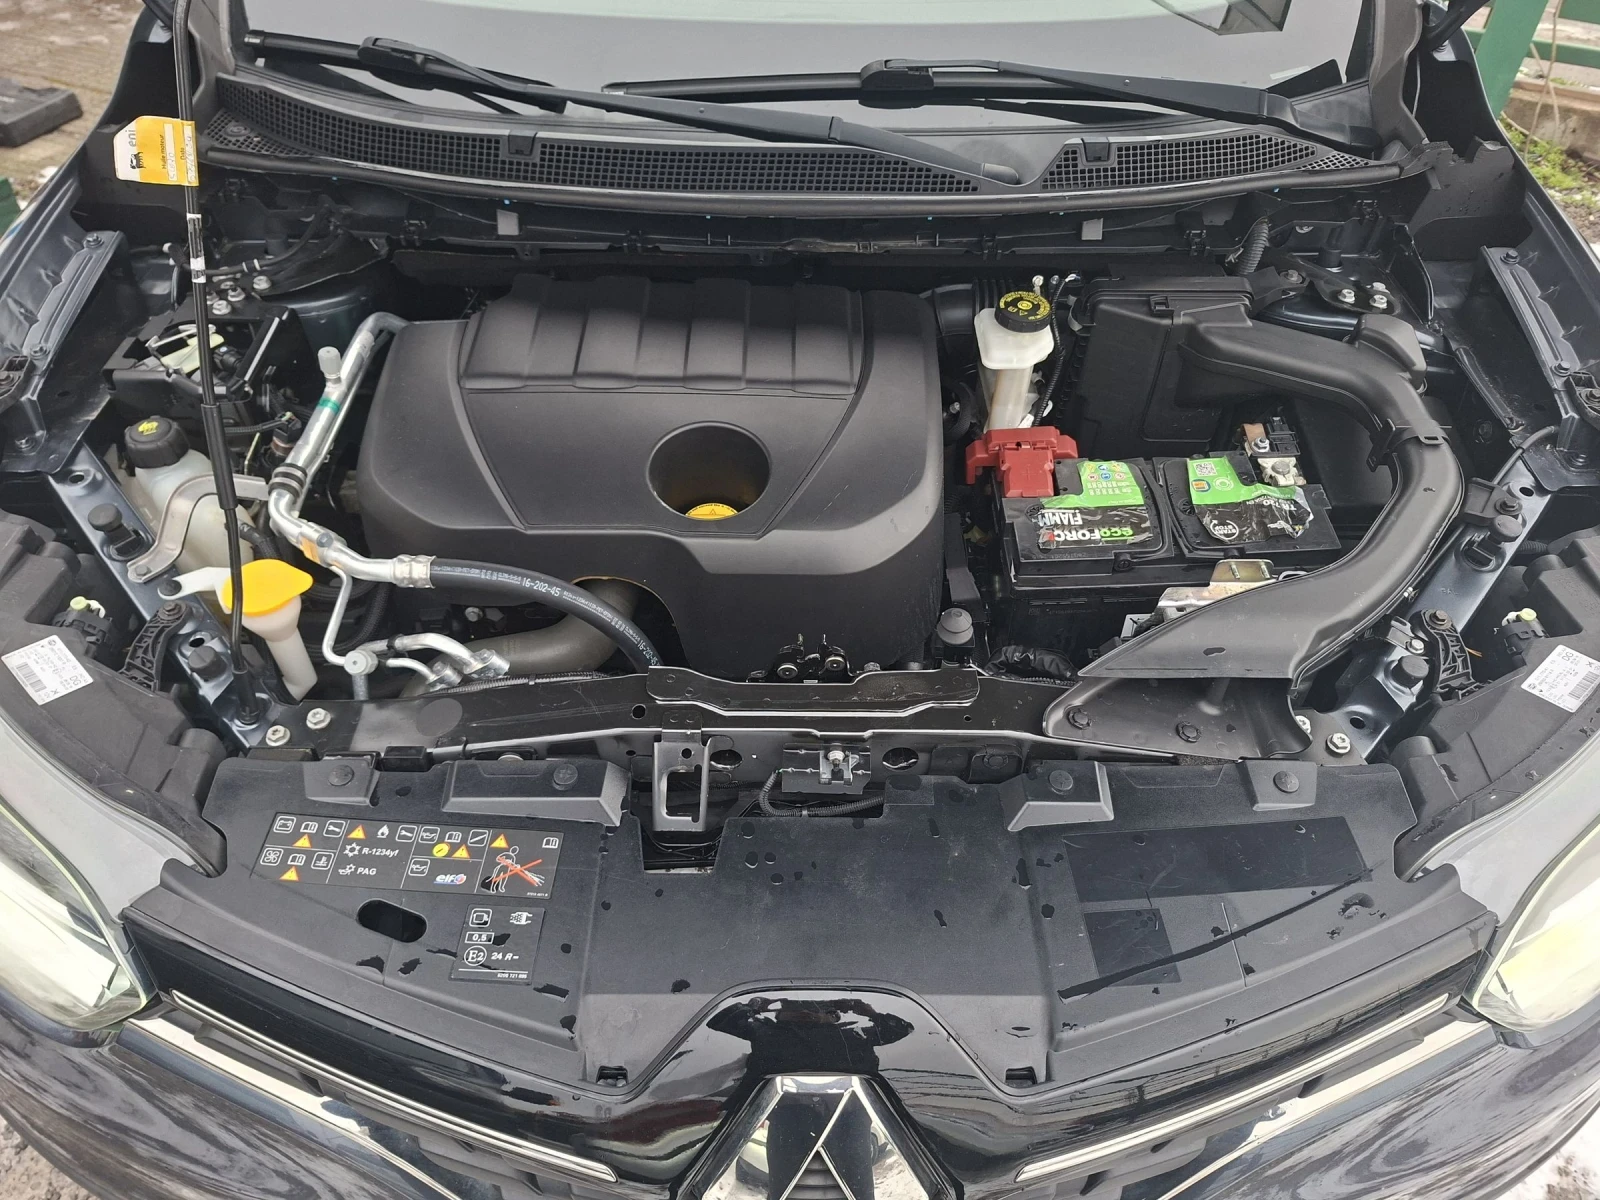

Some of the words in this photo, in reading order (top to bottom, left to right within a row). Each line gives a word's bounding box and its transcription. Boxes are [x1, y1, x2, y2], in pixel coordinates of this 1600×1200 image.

[125, 129, 137, 148] eni
[1050, 527, 1134, 542] ecoFORC
[521, 577, 562, 597] 16-202-45
[361, 846, 399, 858] R-1234yf
[356, 867, 377, 876] PAG
[435, 873, 457, 883] elf
[472, 933, 487, 942] 0,5
[467, 949, 485, 962] E2
[490, 952, 503, 960] 24
